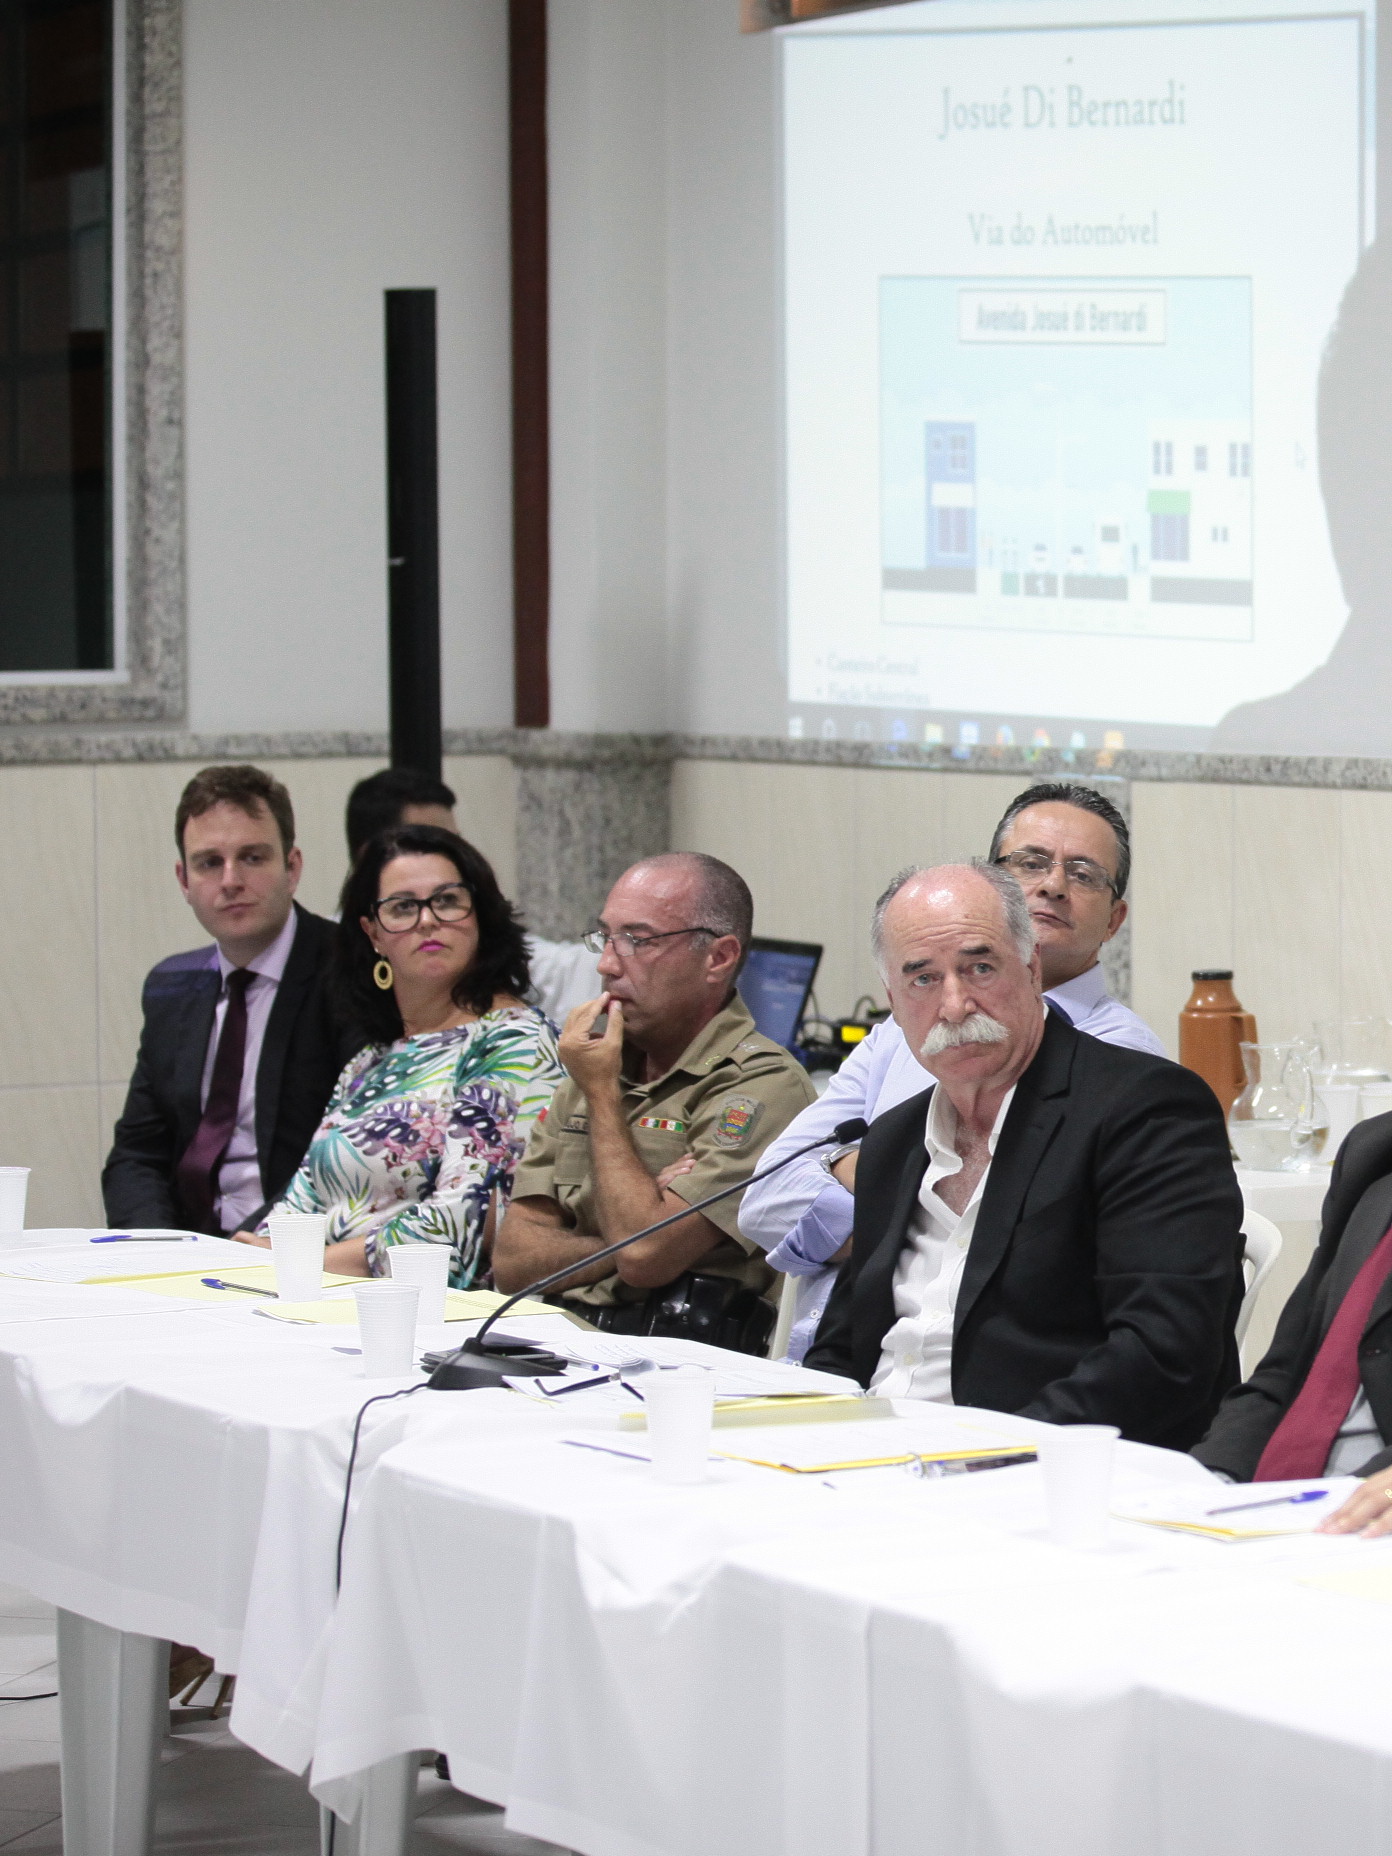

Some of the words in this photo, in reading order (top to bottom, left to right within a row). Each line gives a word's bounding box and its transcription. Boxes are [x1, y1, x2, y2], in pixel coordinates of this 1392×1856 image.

[937, 86, 1012, 140] Josué
[1022, 83, 1057, 128] Di
[1066, 78, 1186, 128] Bernardi
[967, 212, 1004, 246] Via
[1009, 210, 1036, 246] do
[1041, 209, 1160, 246] Automóvel
[976, 302, 1027, 332] Avenida
[1031, 302, 1069, 332] Josué
[1089, 302, 1147, 332] Bernardi
